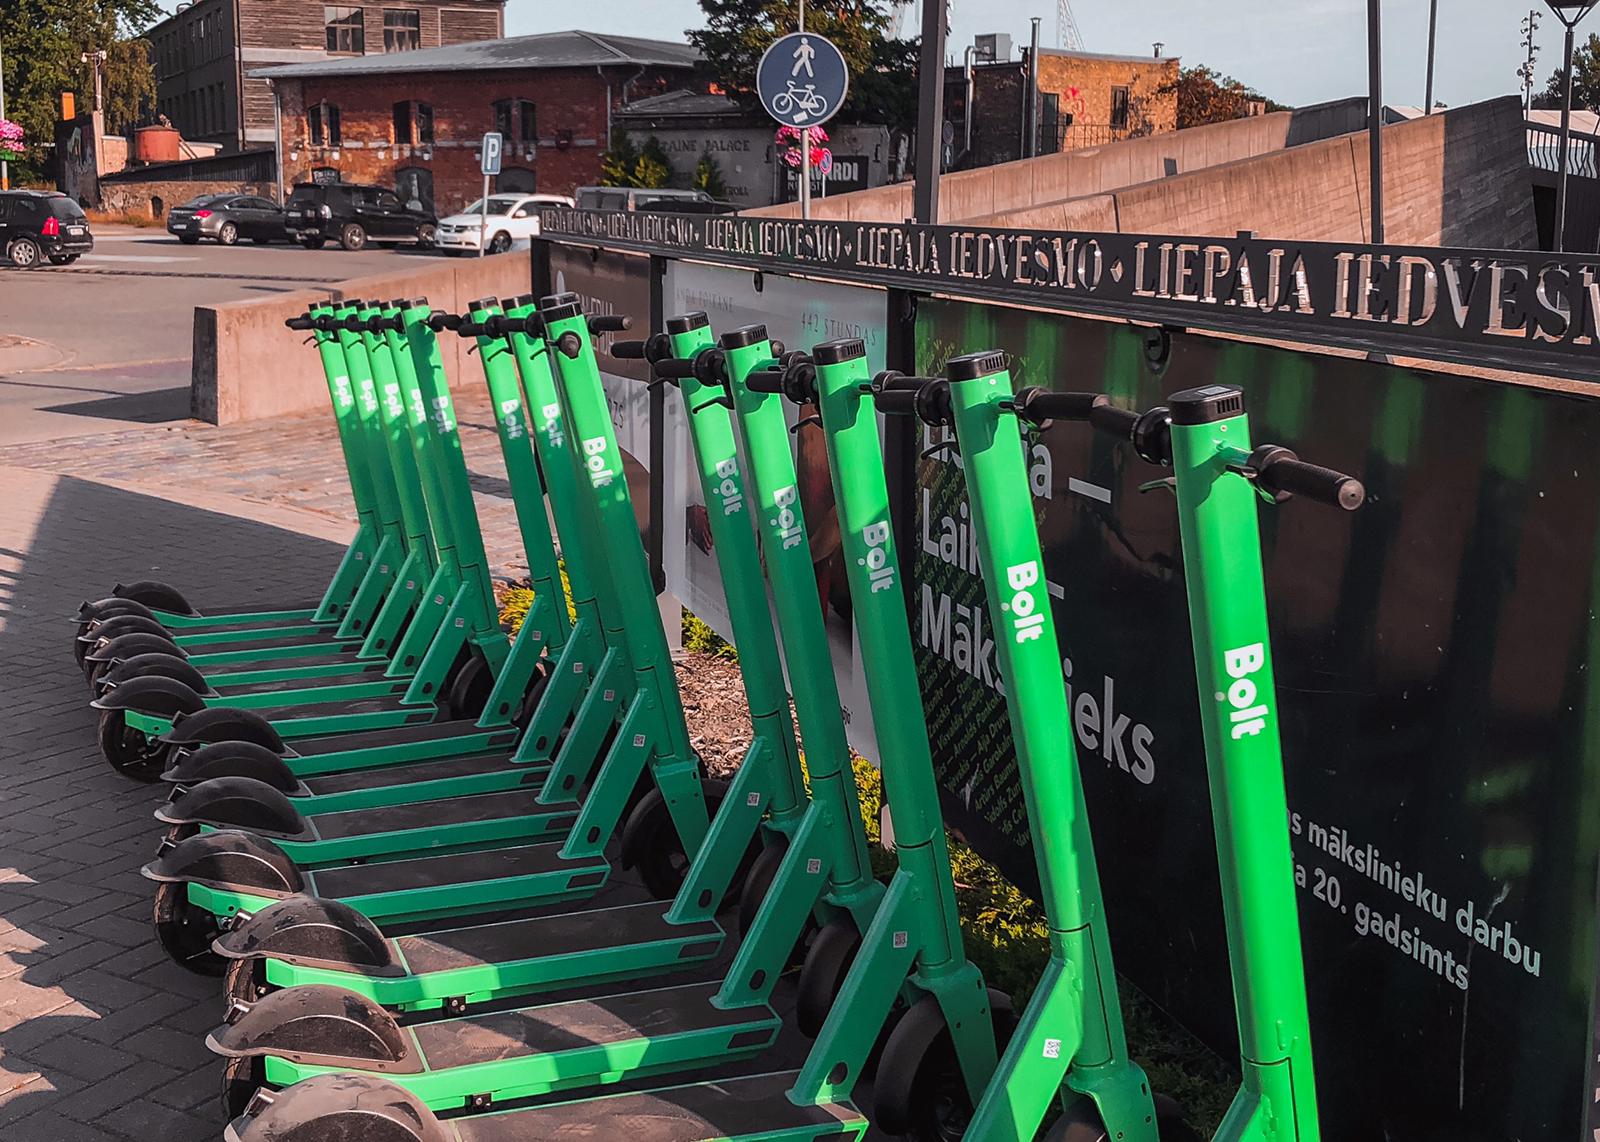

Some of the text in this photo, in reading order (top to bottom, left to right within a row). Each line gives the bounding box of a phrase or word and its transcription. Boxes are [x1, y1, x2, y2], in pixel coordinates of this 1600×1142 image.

[487, 139, 499, 170] P
[758, 221, 841, 263] IEDVESMO
[855, 226, 941, 275] LIEPAJA
[948, 231, 1103, 292] IEDVESMO
[1131, 241, 1315, 315] LIEPAJA
[824, 318, 877, 347] STUNDAS
[500, 399, 523, 439] Bolt
[540, 403, 564, 448] Bolt
[582, 436, 613, 488] Bolt
[712, 457, 742, 516] Bolt
[770, 485, 802, 550] Bolt
[857, 520, 895, 594] Bolt
[1000, 560, 1045, 644] Bolt
[1215, 642, 1269, 740] Bolt
[1307, 820, 1447, 922] mākslinieku
[1455, 900, 1541, 977] darbu
[1312, 867, 1347, 914] 20.
[1354, 902, 1469, 991] gadsimts
